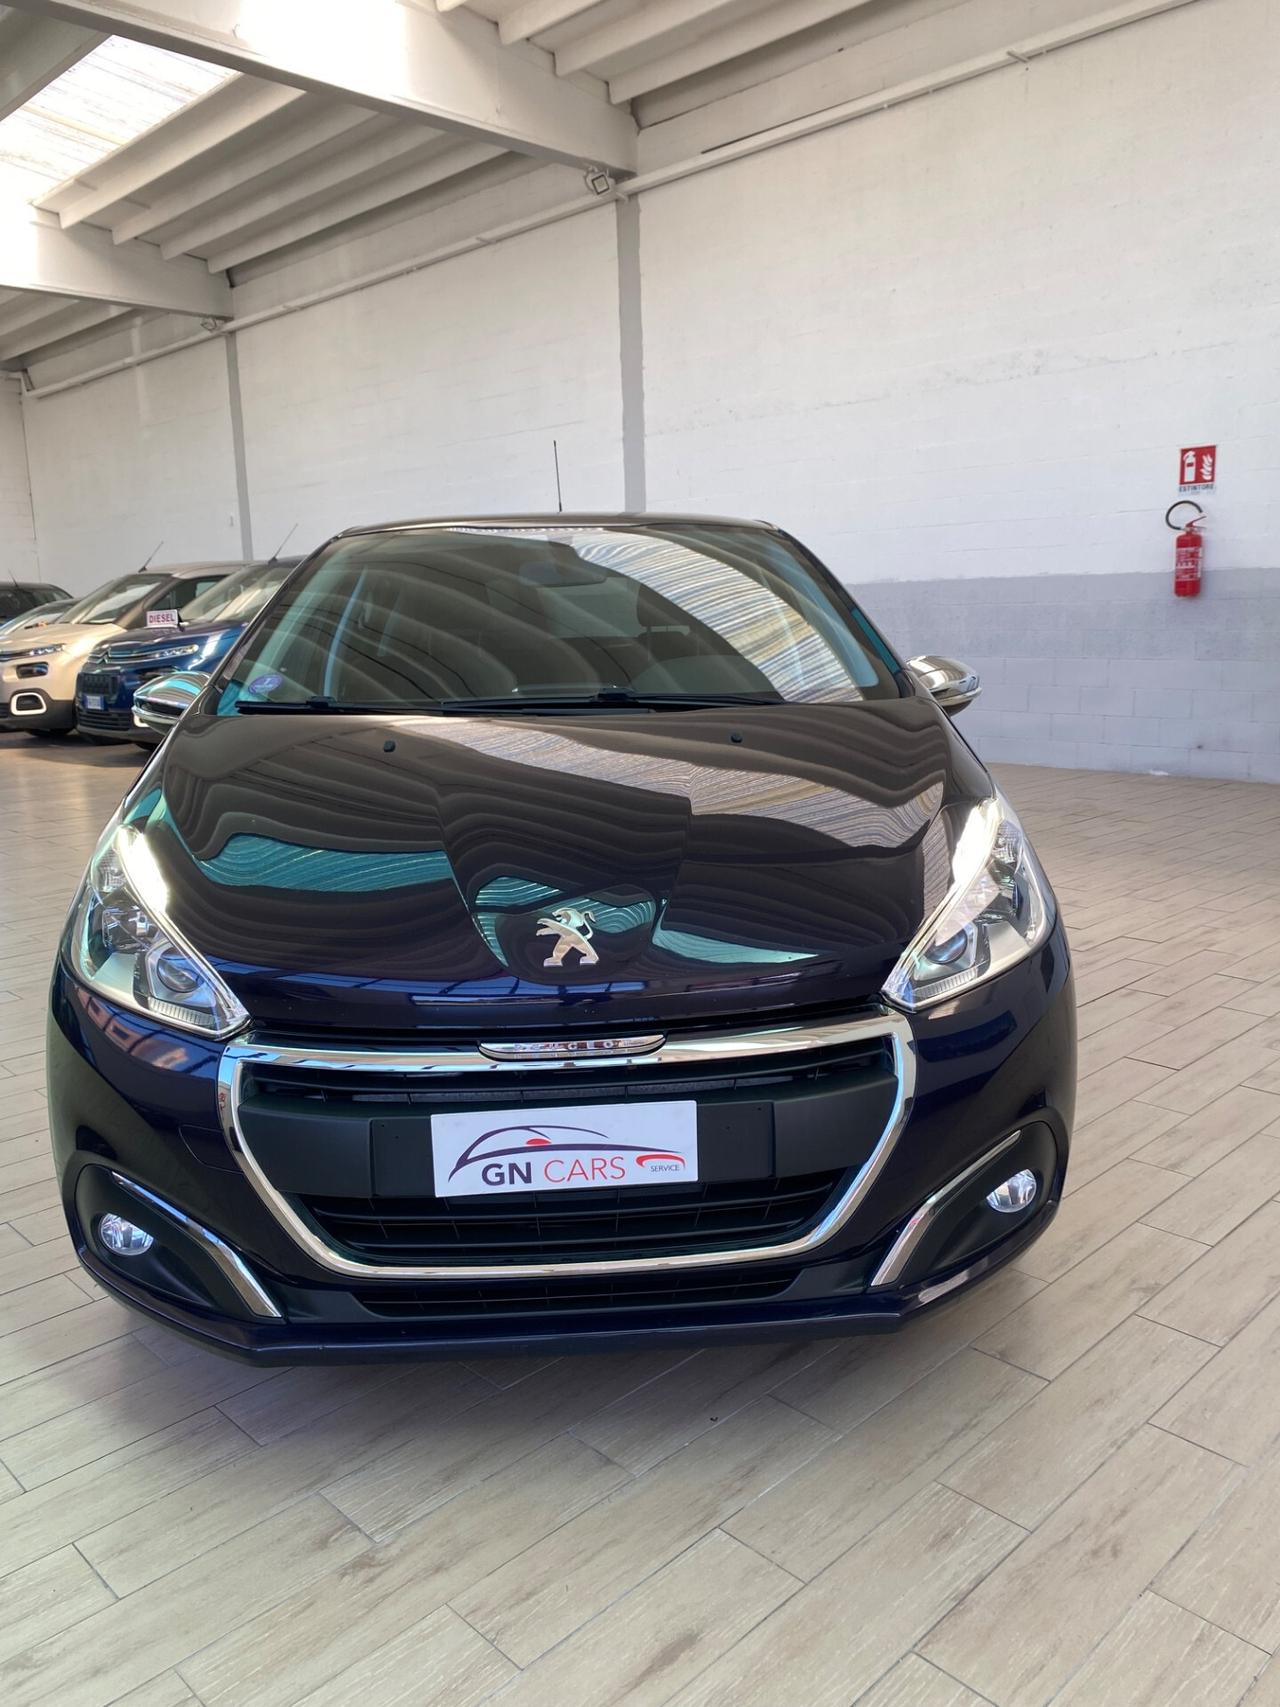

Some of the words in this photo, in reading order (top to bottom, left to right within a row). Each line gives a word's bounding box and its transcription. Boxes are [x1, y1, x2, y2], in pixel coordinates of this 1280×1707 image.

[149, 612, 175, 624] DIESEL
[481, 1161, 532, 1186] GN
[543, 1156, 626, 1183] CARS
[650, 1164, 680, 1172] SERVICE
